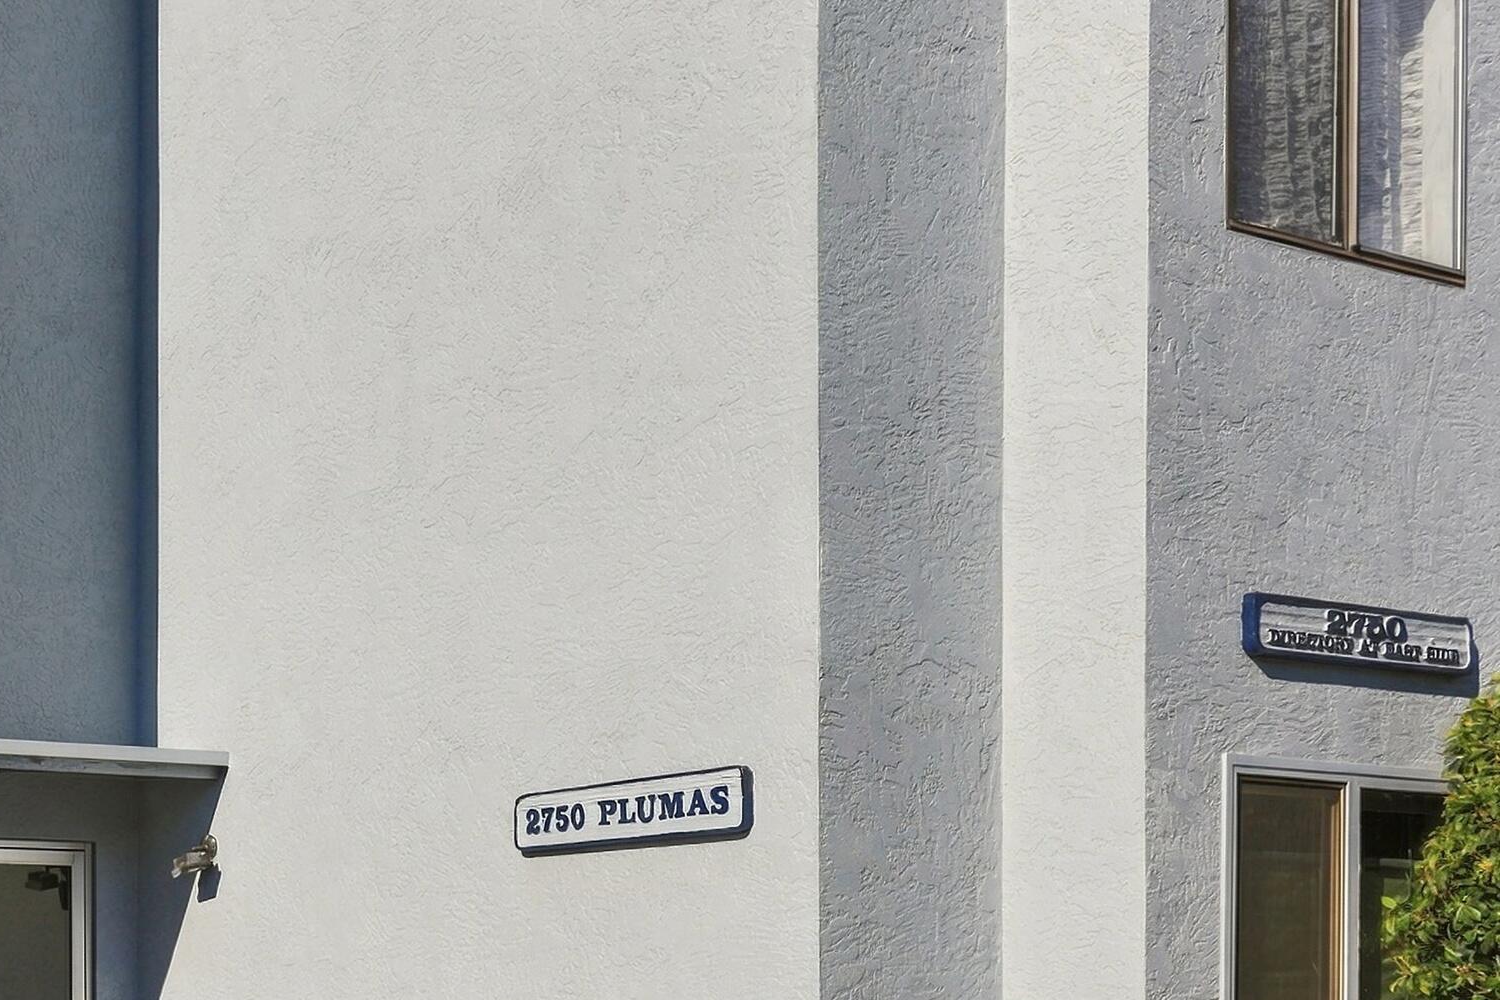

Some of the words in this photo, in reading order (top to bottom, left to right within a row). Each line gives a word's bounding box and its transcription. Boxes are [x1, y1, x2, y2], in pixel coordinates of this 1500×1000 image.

[1326, 610, 1408, 643] 2750
[526, 803, 586, 835] 2750
[598, 786, 729, 826] PLUMAS
